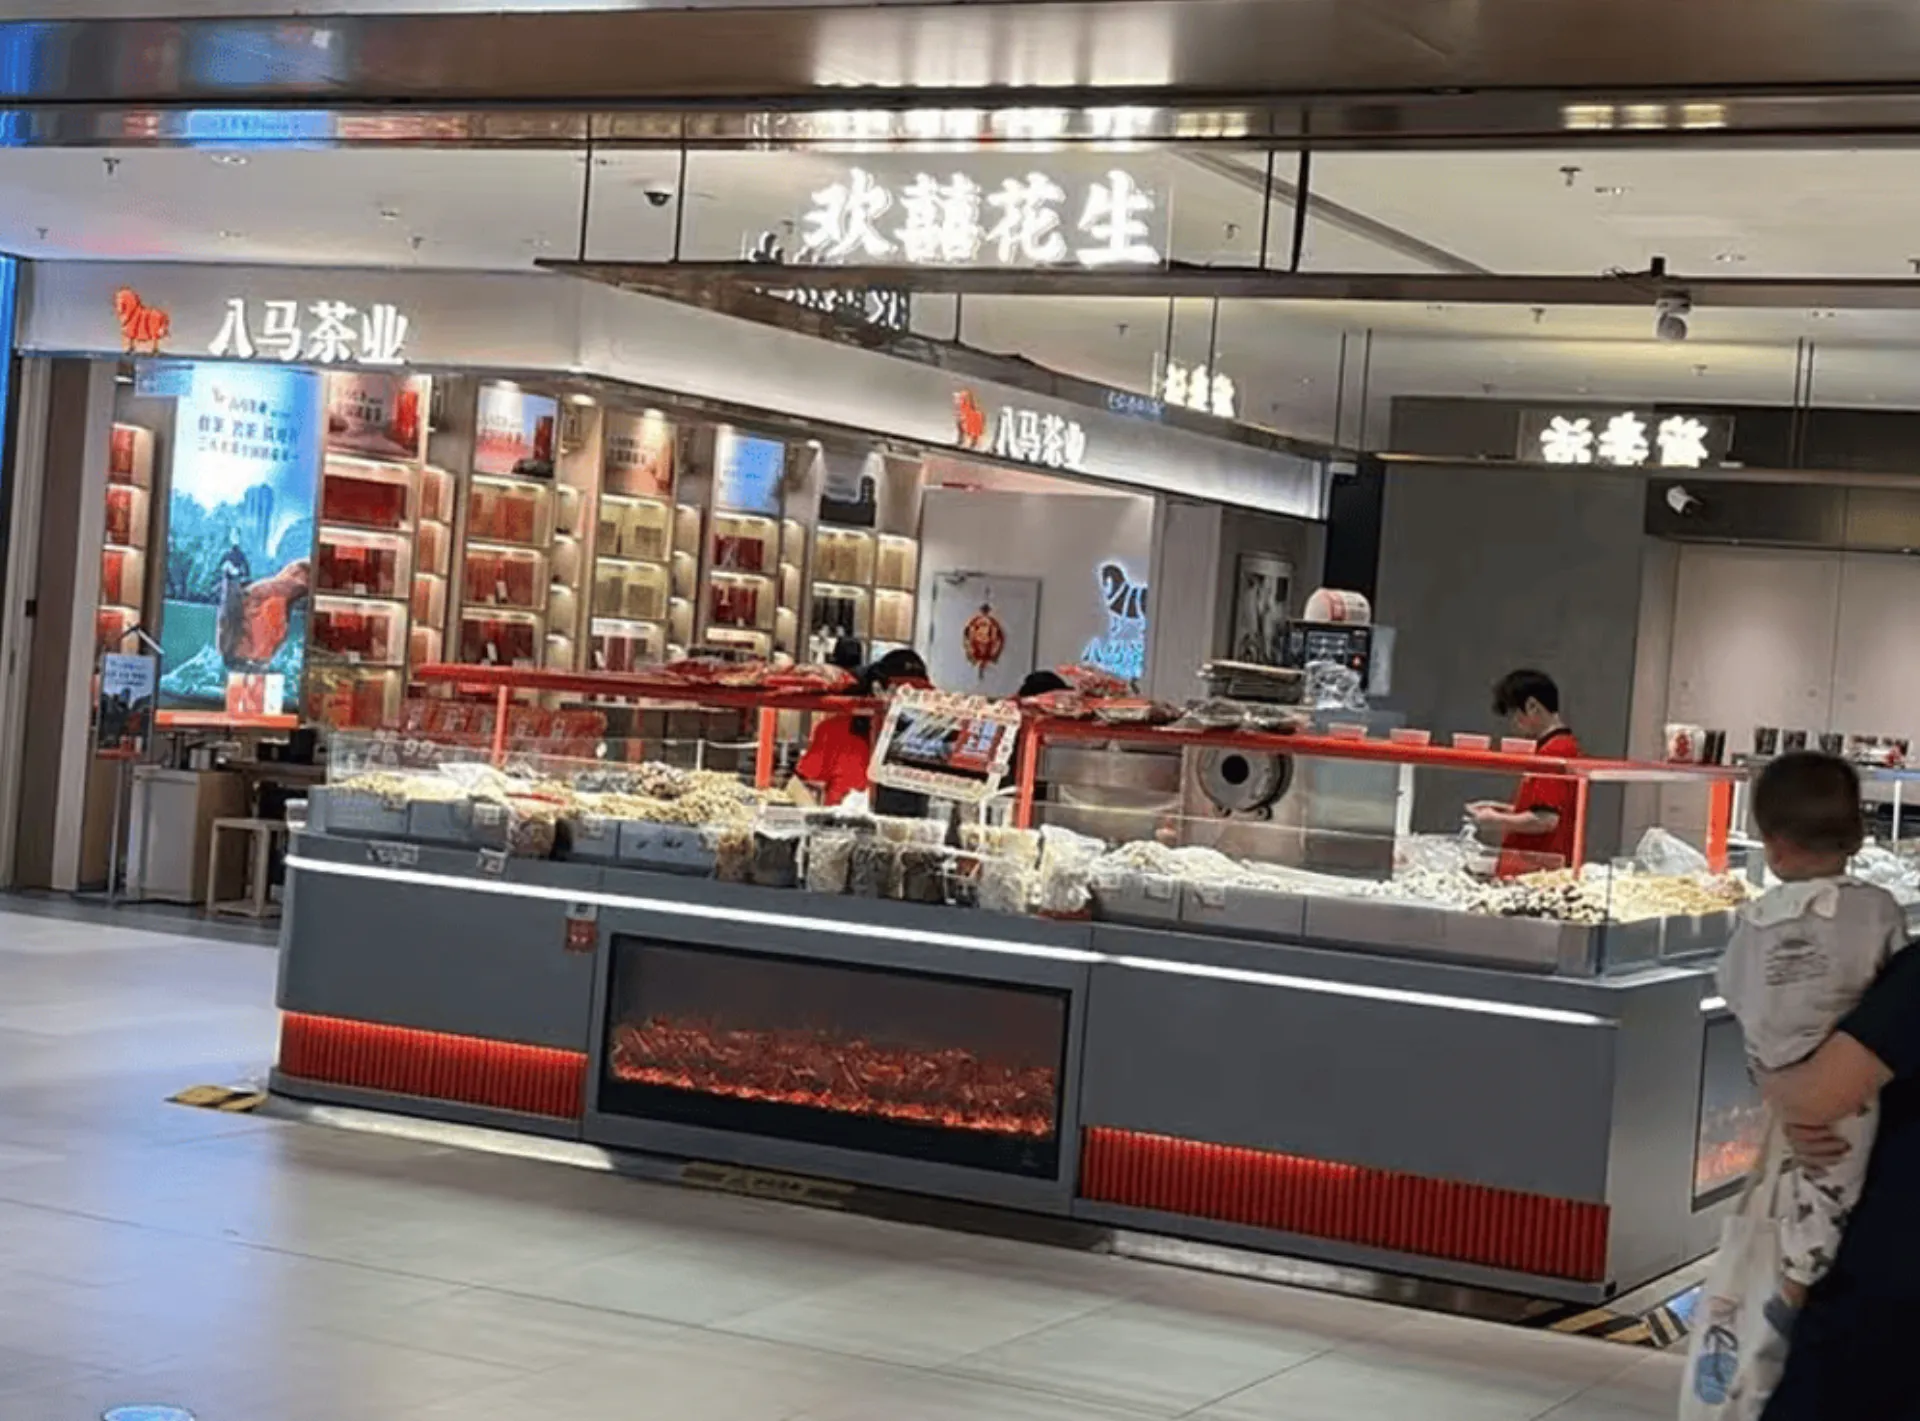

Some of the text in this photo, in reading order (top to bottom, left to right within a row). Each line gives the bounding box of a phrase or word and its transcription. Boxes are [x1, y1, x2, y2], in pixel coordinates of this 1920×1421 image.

[207, 297, 409, 365] 八马茶业
[997, 405, 1086, 467] 八马茶业
